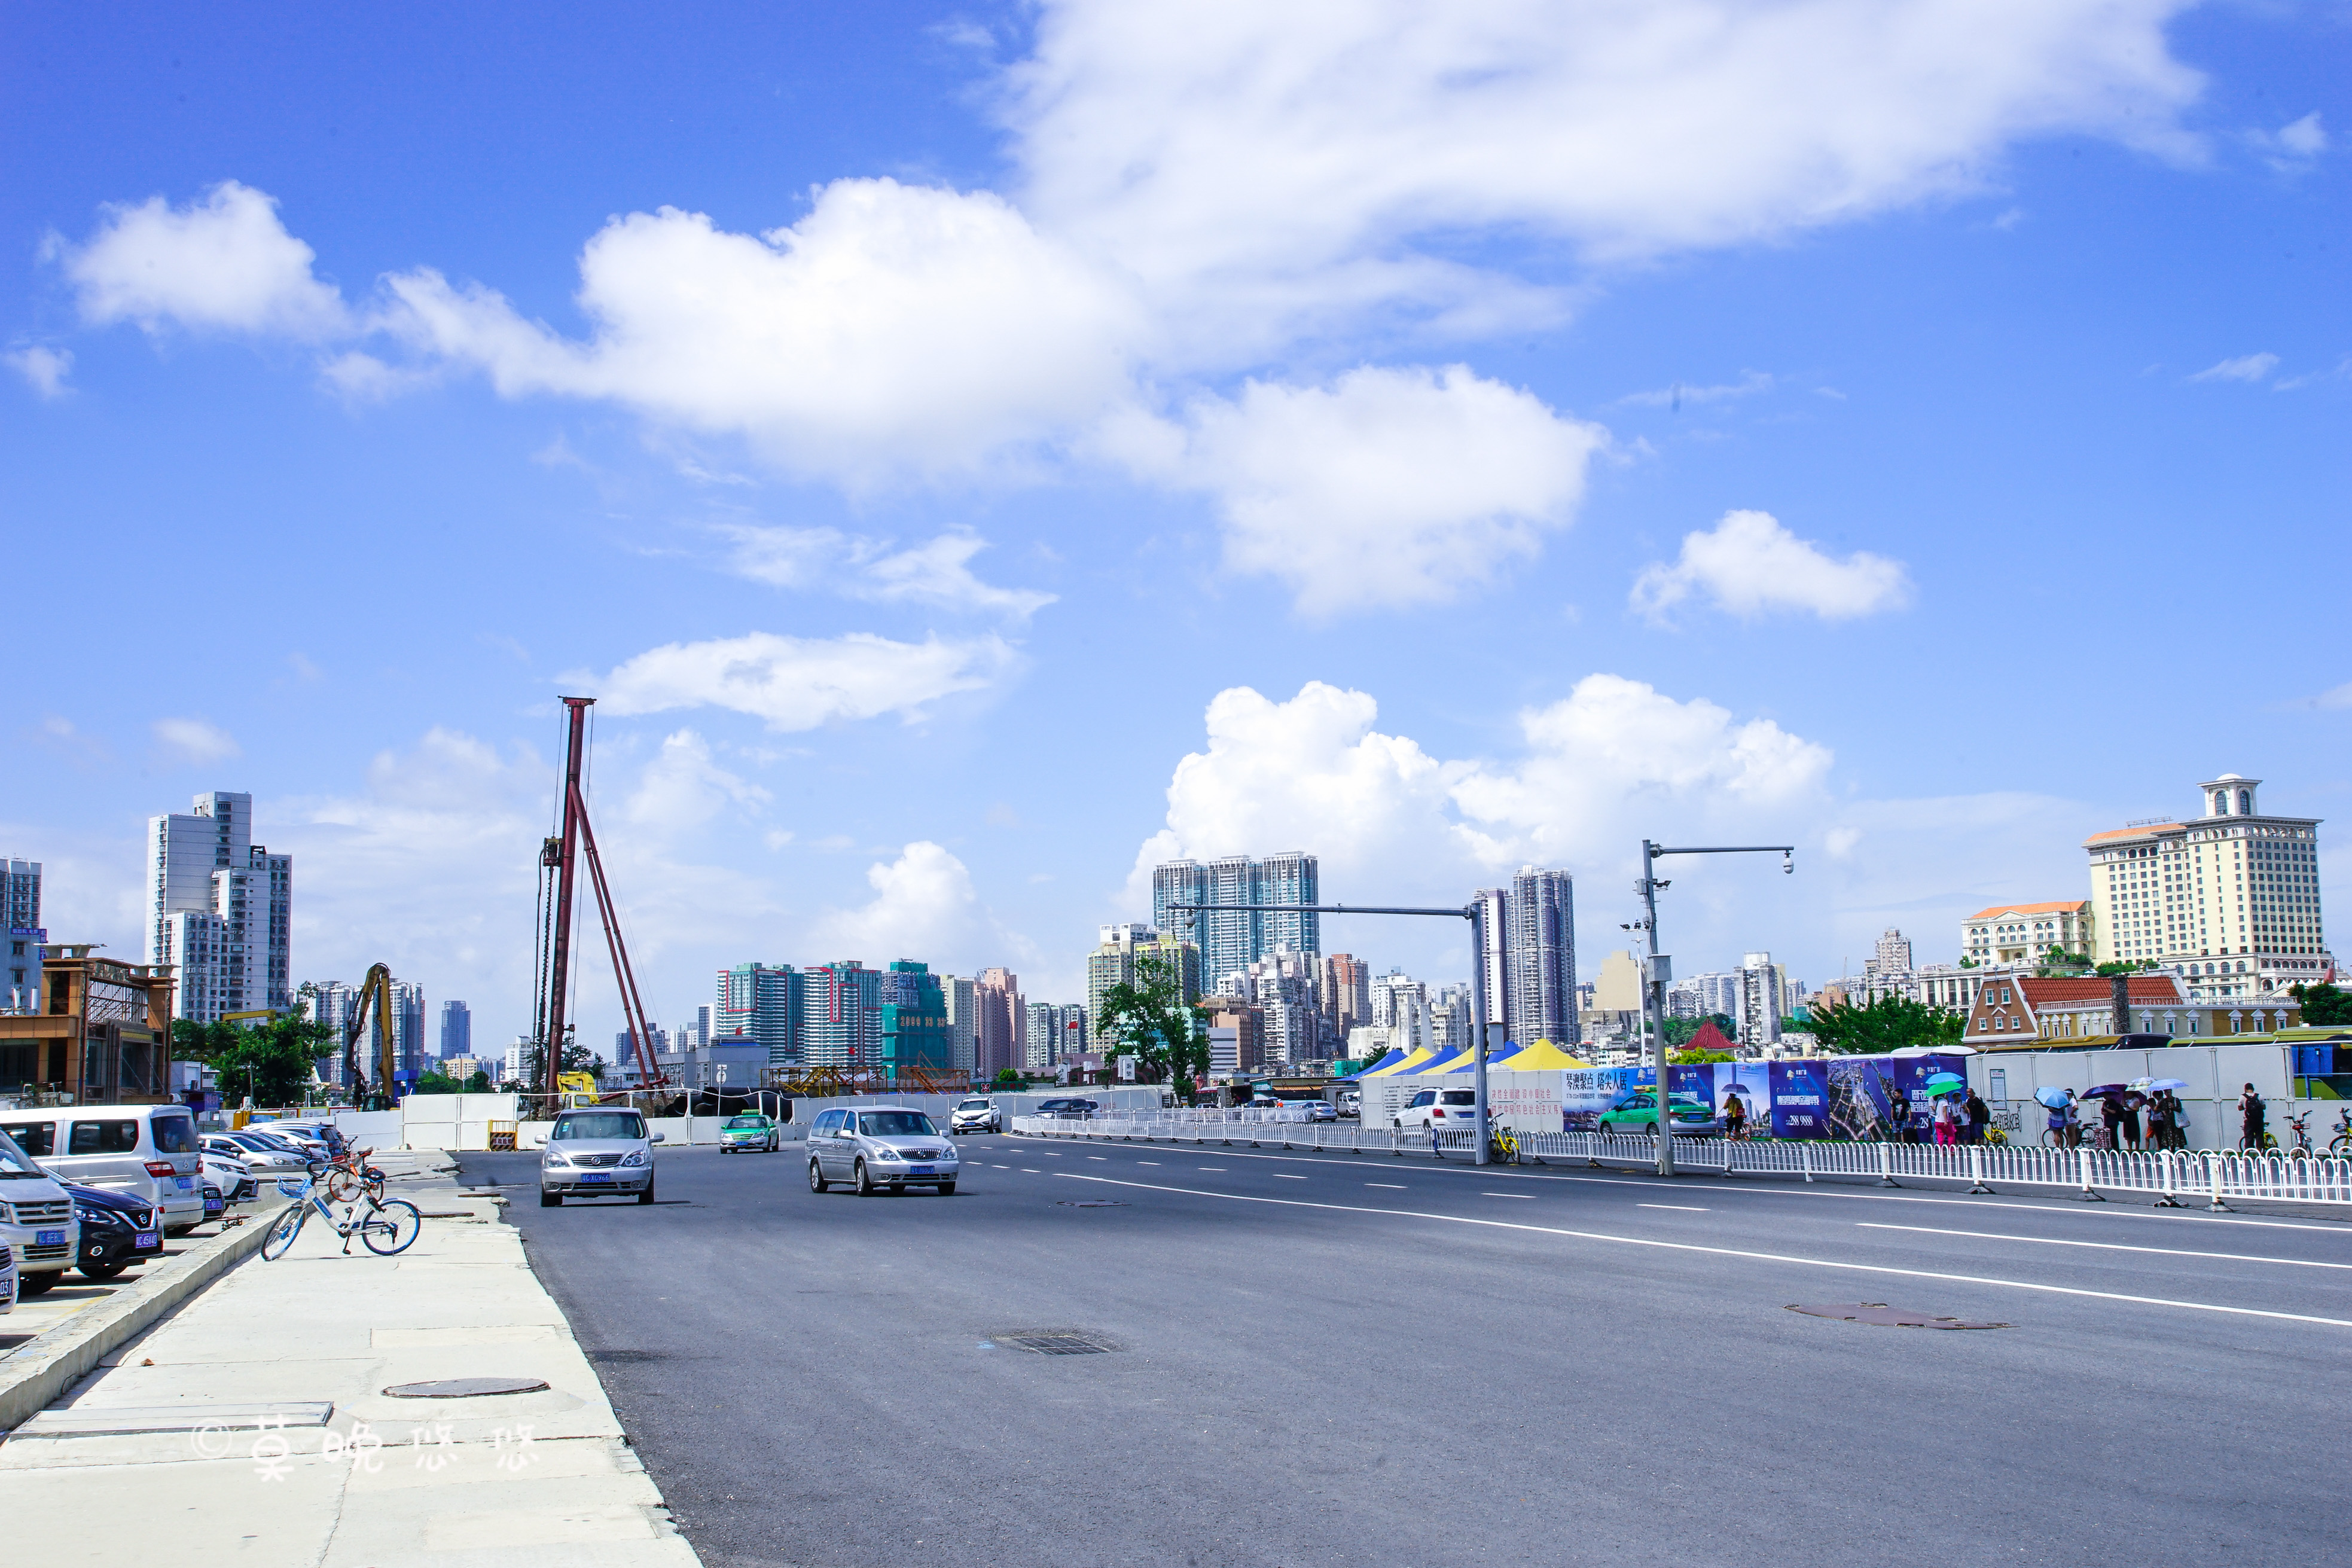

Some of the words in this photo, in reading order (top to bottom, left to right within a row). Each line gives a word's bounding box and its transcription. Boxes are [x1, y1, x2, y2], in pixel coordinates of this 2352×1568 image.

[1566, 1073, 1594, 1090] 琴澳聚点
[1597, 1072, 1627, 1090] 塔尖人居
